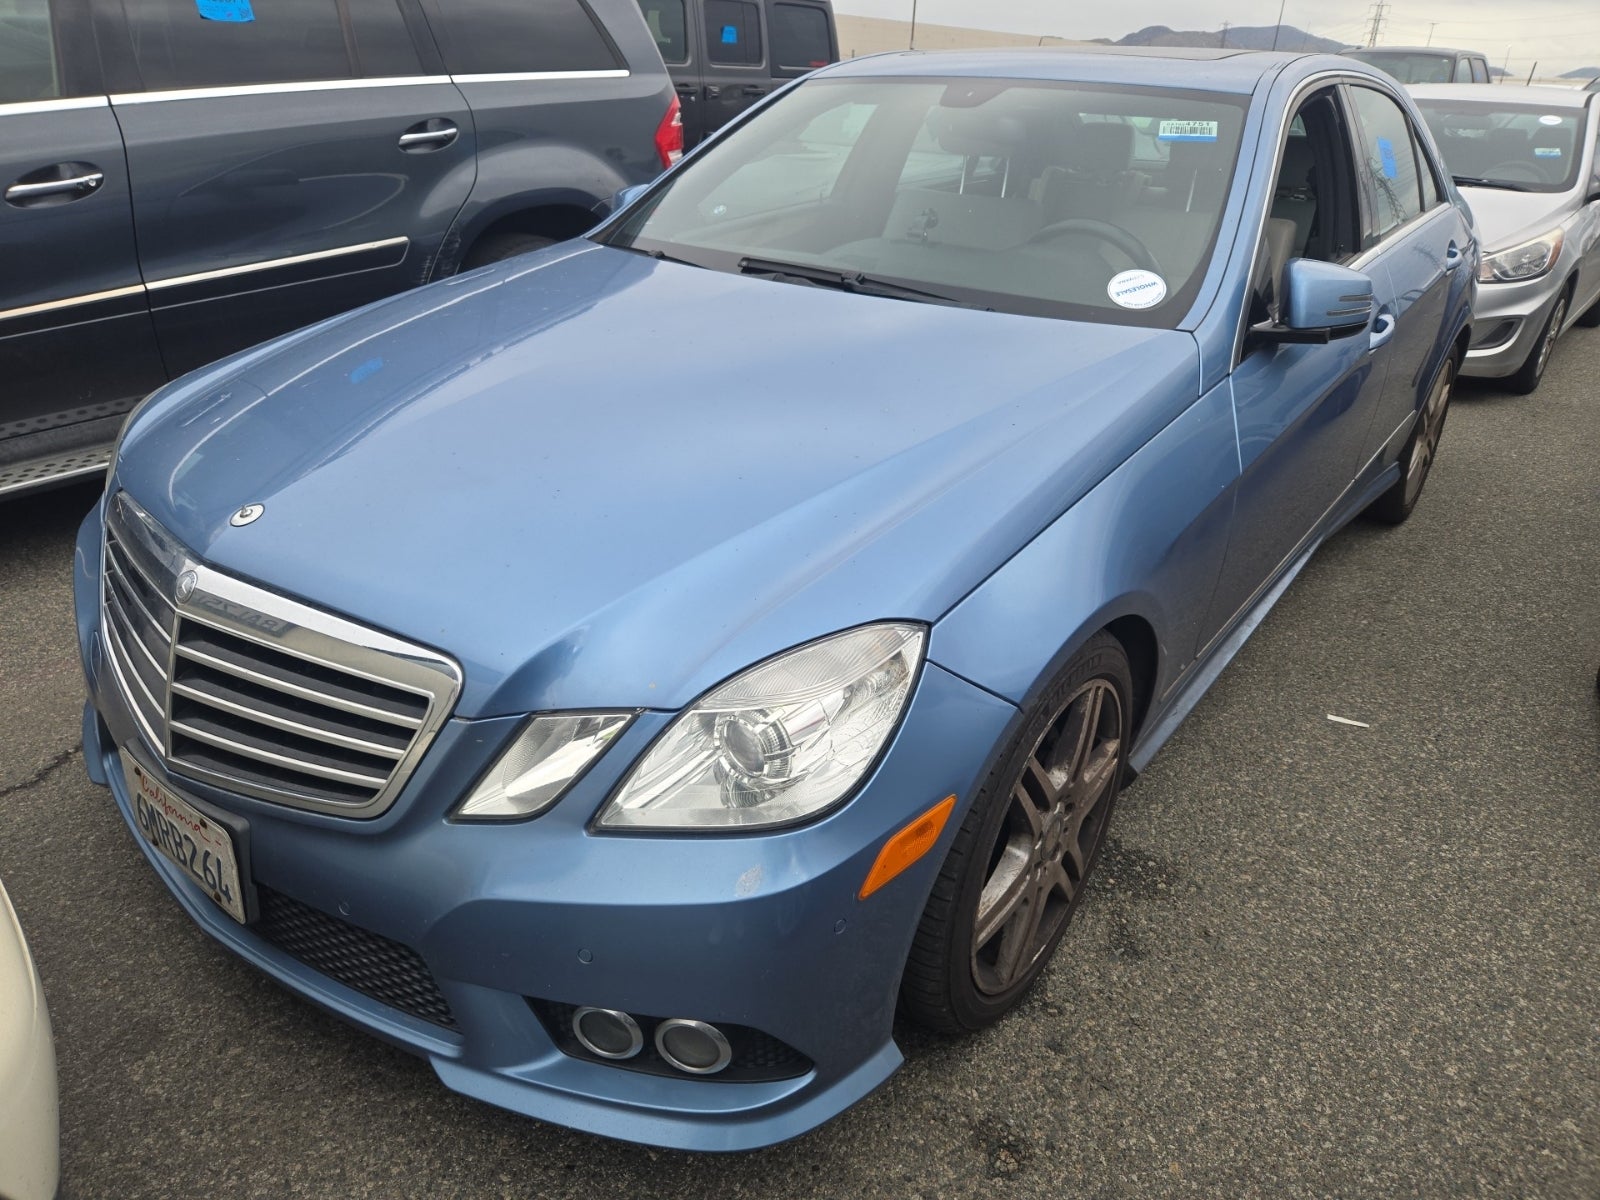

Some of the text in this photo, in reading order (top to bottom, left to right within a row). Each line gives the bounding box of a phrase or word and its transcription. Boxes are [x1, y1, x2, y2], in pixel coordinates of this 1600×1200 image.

[1115, 281, 1158, 297] WHOLESALE
[140, 773, 209, 842] California
[136, 792, 233, 905] 6MRB264
